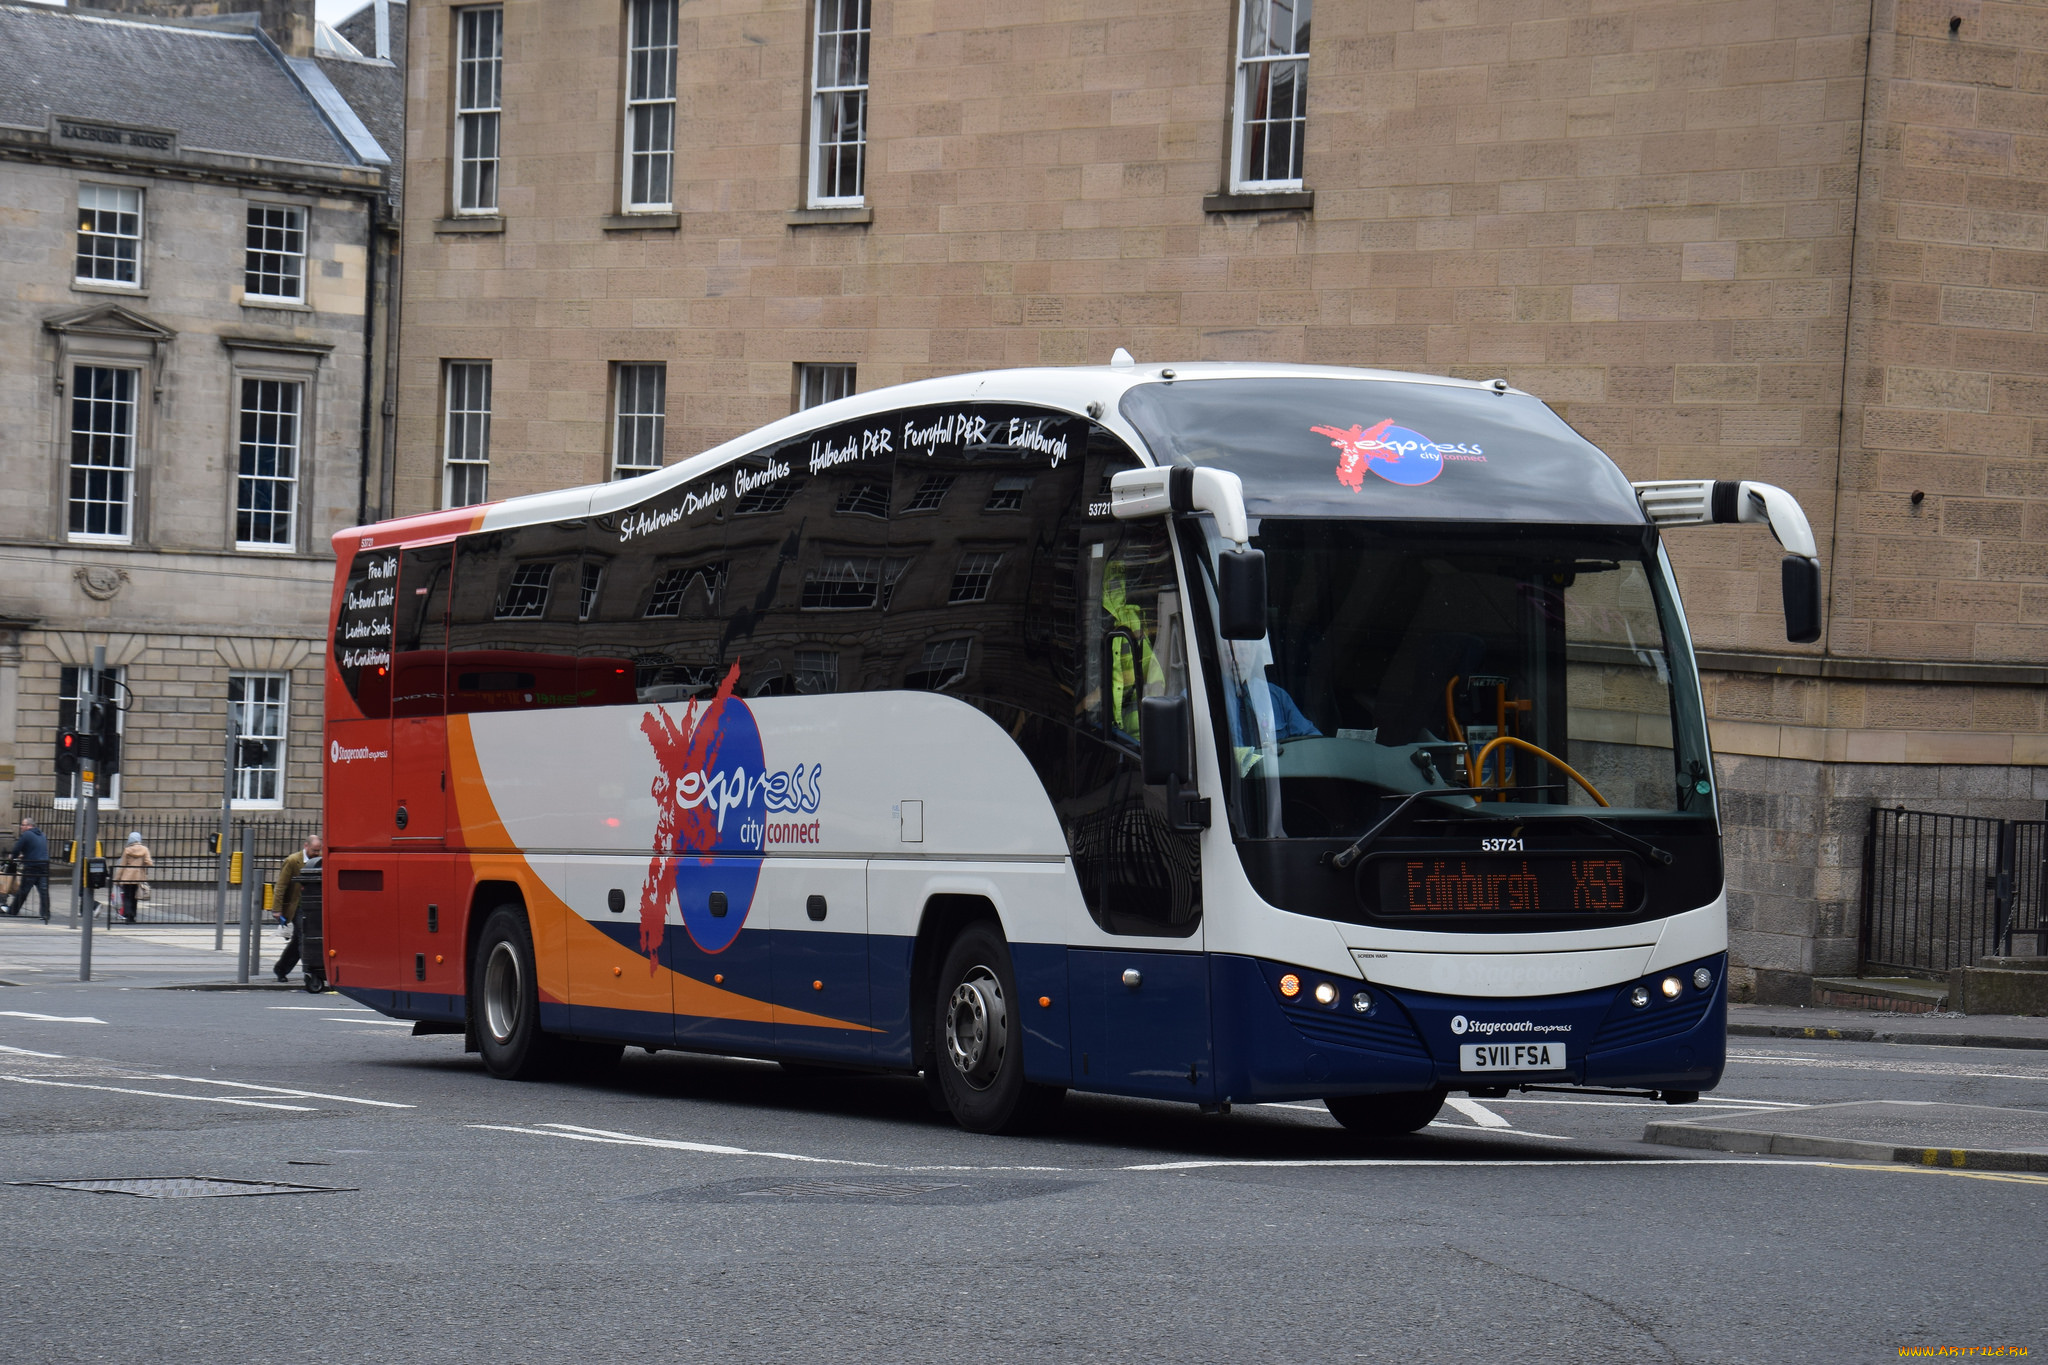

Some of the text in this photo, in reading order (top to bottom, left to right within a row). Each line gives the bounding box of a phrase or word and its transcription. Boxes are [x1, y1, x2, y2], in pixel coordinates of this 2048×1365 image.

[61, 124, 169, 150] RAEBURN HOUSE
[1355, 440, 1484, 456] express
[1420, 452, 1488, 463] city connect
[620, 518, 635, 542] St
[734, 458, 791, 498] Glenrothes
[809, 436, 858, 476] Halbeath
[862, 429, 893, 460] P&R
[904, 415, 953, 456] Ferrytoll
[955, 413, 988, 445] P&R
[1008, 417, 1068, 469] Edinburgh
[1088, 502, 1112, 517] 53721
[368, 561, 382, 580] Free
[349, 587, 395, 611] On-board Toilet
[345, 617, 392, 640] Leather Seats
[343, 647, 390, 671] Air Conditioning
[339, 746, 388, 764] Stagecoach express
[675, 763, 821, 833] express
[740, 817, 820, 850] city connect
[1482, 838, 1524, 851] 53721
[1407, 860, 1625, 910] Edinburgh X59
[1468, 1020, 1572, 1035] Stagecoach express
[1475, 1045, 1551, 1066] SV11 FSA
